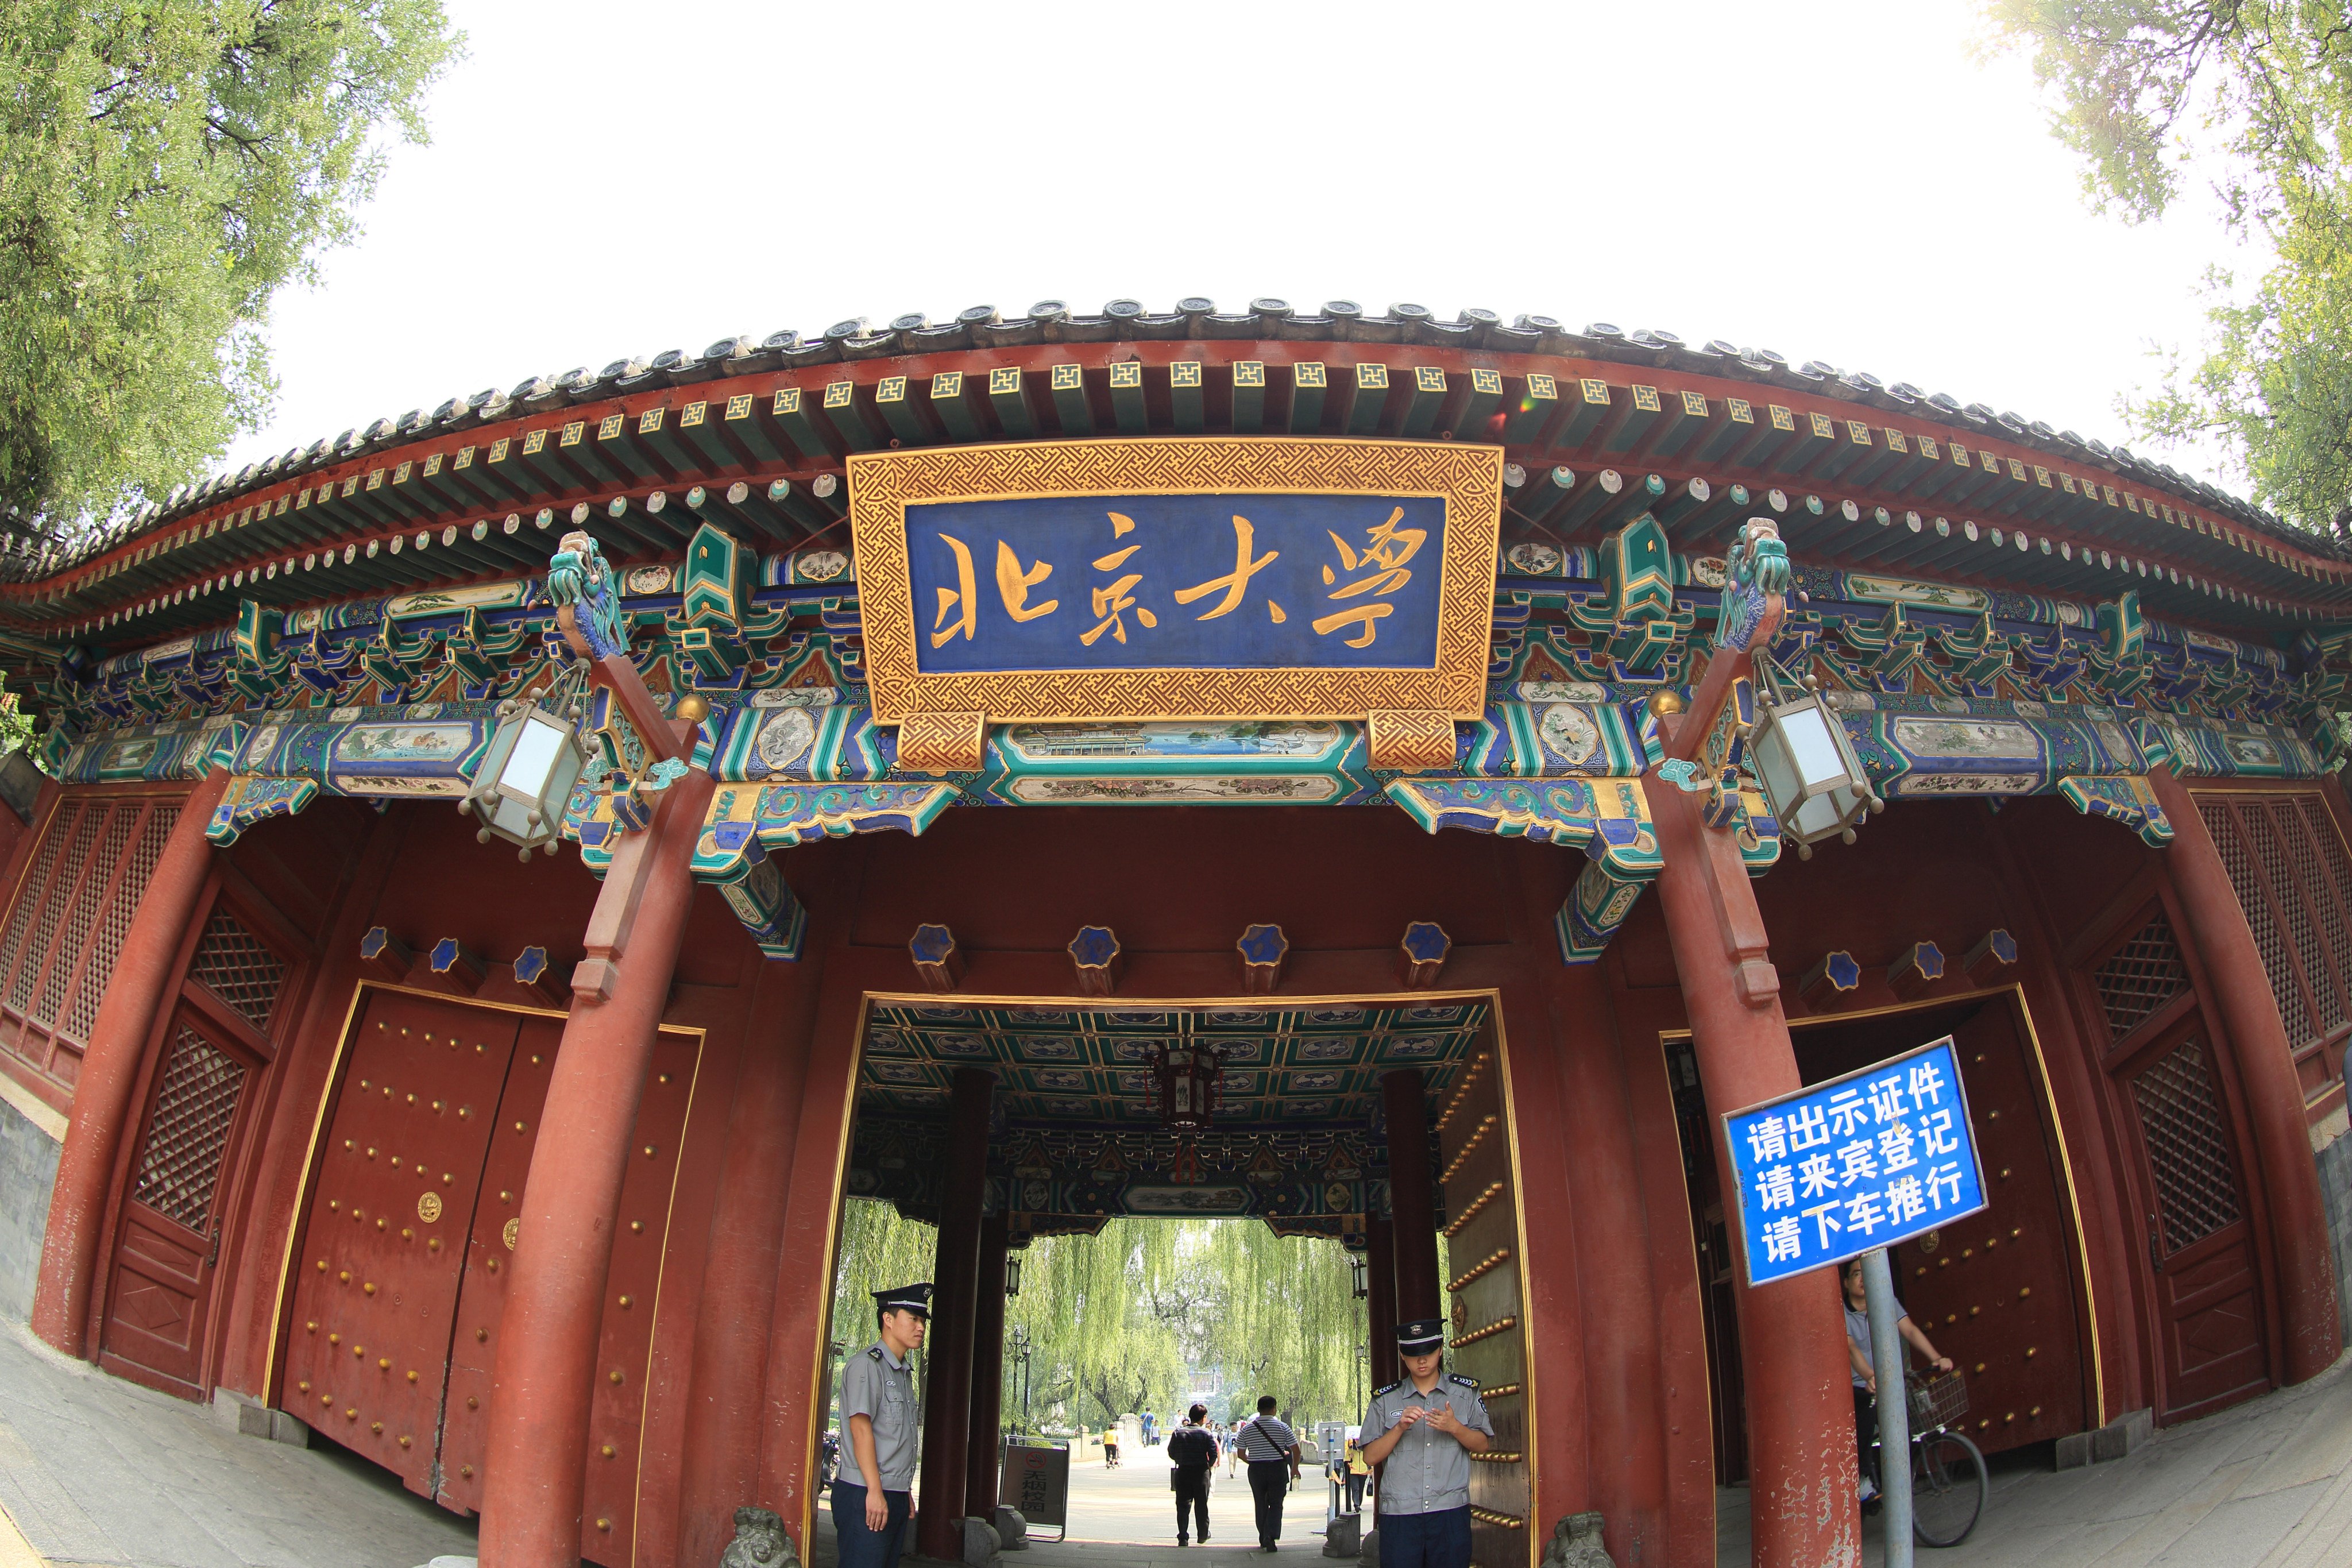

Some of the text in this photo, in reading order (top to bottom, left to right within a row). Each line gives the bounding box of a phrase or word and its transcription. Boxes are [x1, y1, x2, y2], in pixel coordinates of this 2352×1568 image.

[1747, 1061, 1944, 1164] 请出示证件
[1755, 1108, 1958, 1212] 请来宾登记
[1762, 1161, 1962, 1263] 请下车推行
[1021, 1470, 1046, 1512] 无烟校园
